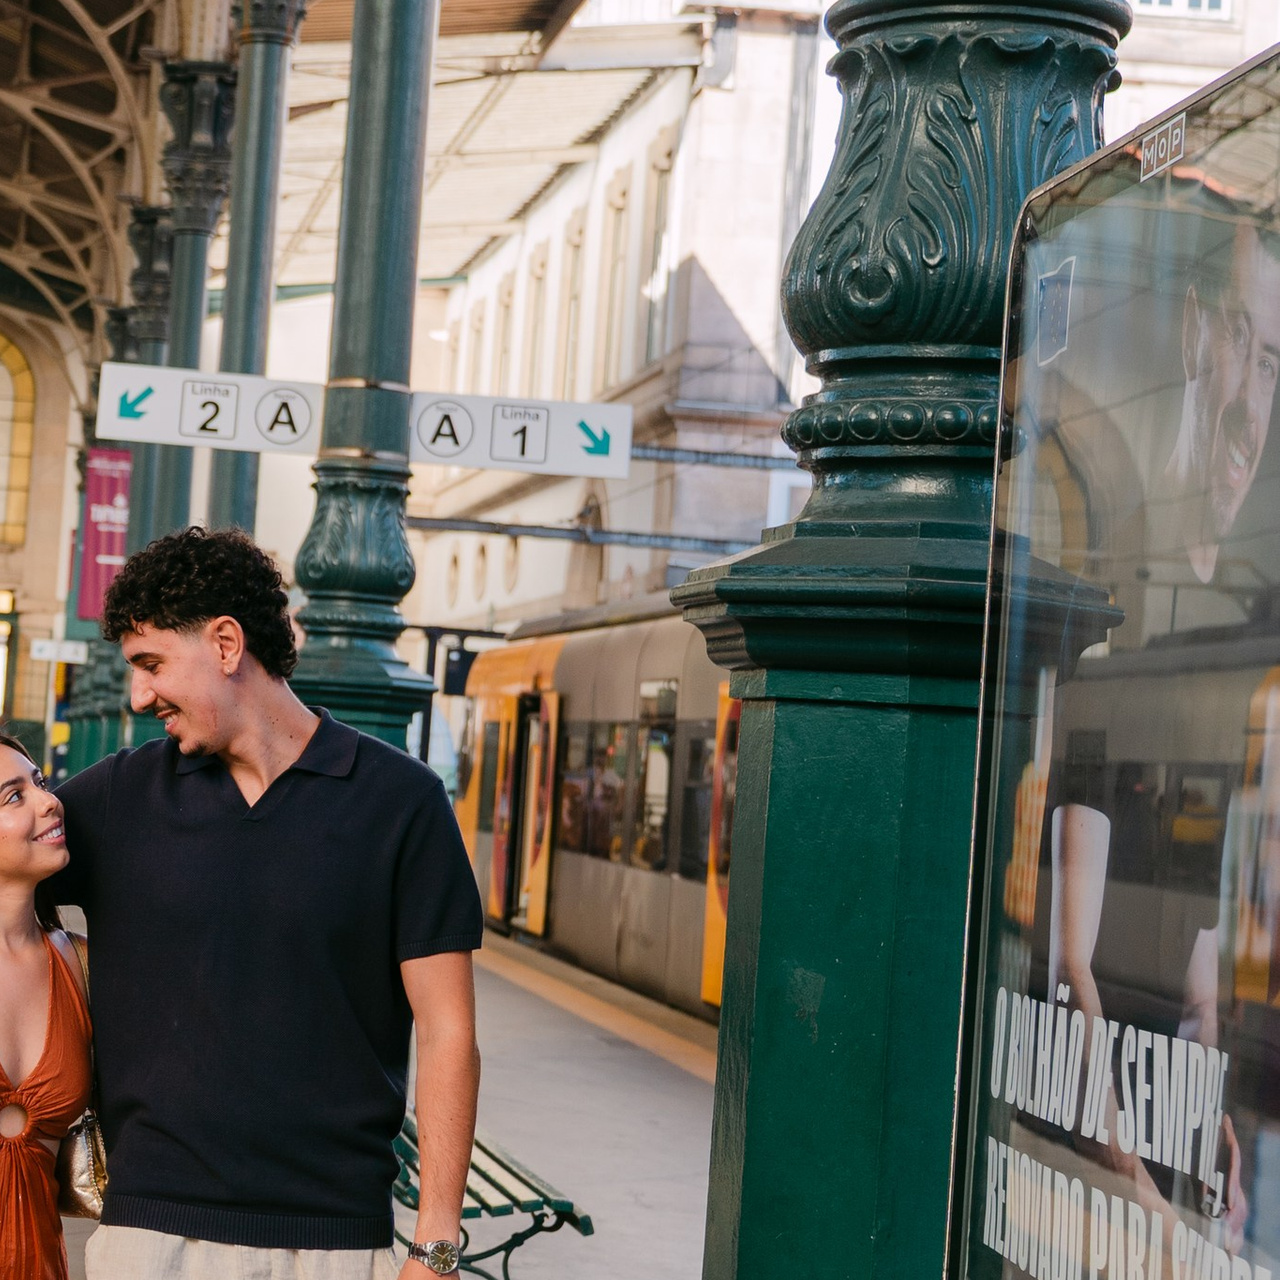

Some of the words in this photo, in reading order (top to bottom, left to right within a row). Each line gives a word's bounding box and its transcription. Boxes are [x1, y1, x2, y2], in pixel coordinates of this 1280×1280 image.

[1143, 127, 1182, 169] MOP
[191, 384, 230, 398] Linha
[199, 401, 220, 432] 2
[268, 401, 297, 433] A
[501, 407, 540, 422] Linha
[430, 414, 459, 446] A
[513, 425, 527, 457] 1
[990, 986, 1007, 1099] O
[1004, 983, 1086, 1132] BOLHÃO
[1080, 1016, 1120, 1146] DE
[1117, 1024, 1230, 1215] SEMPRE,
